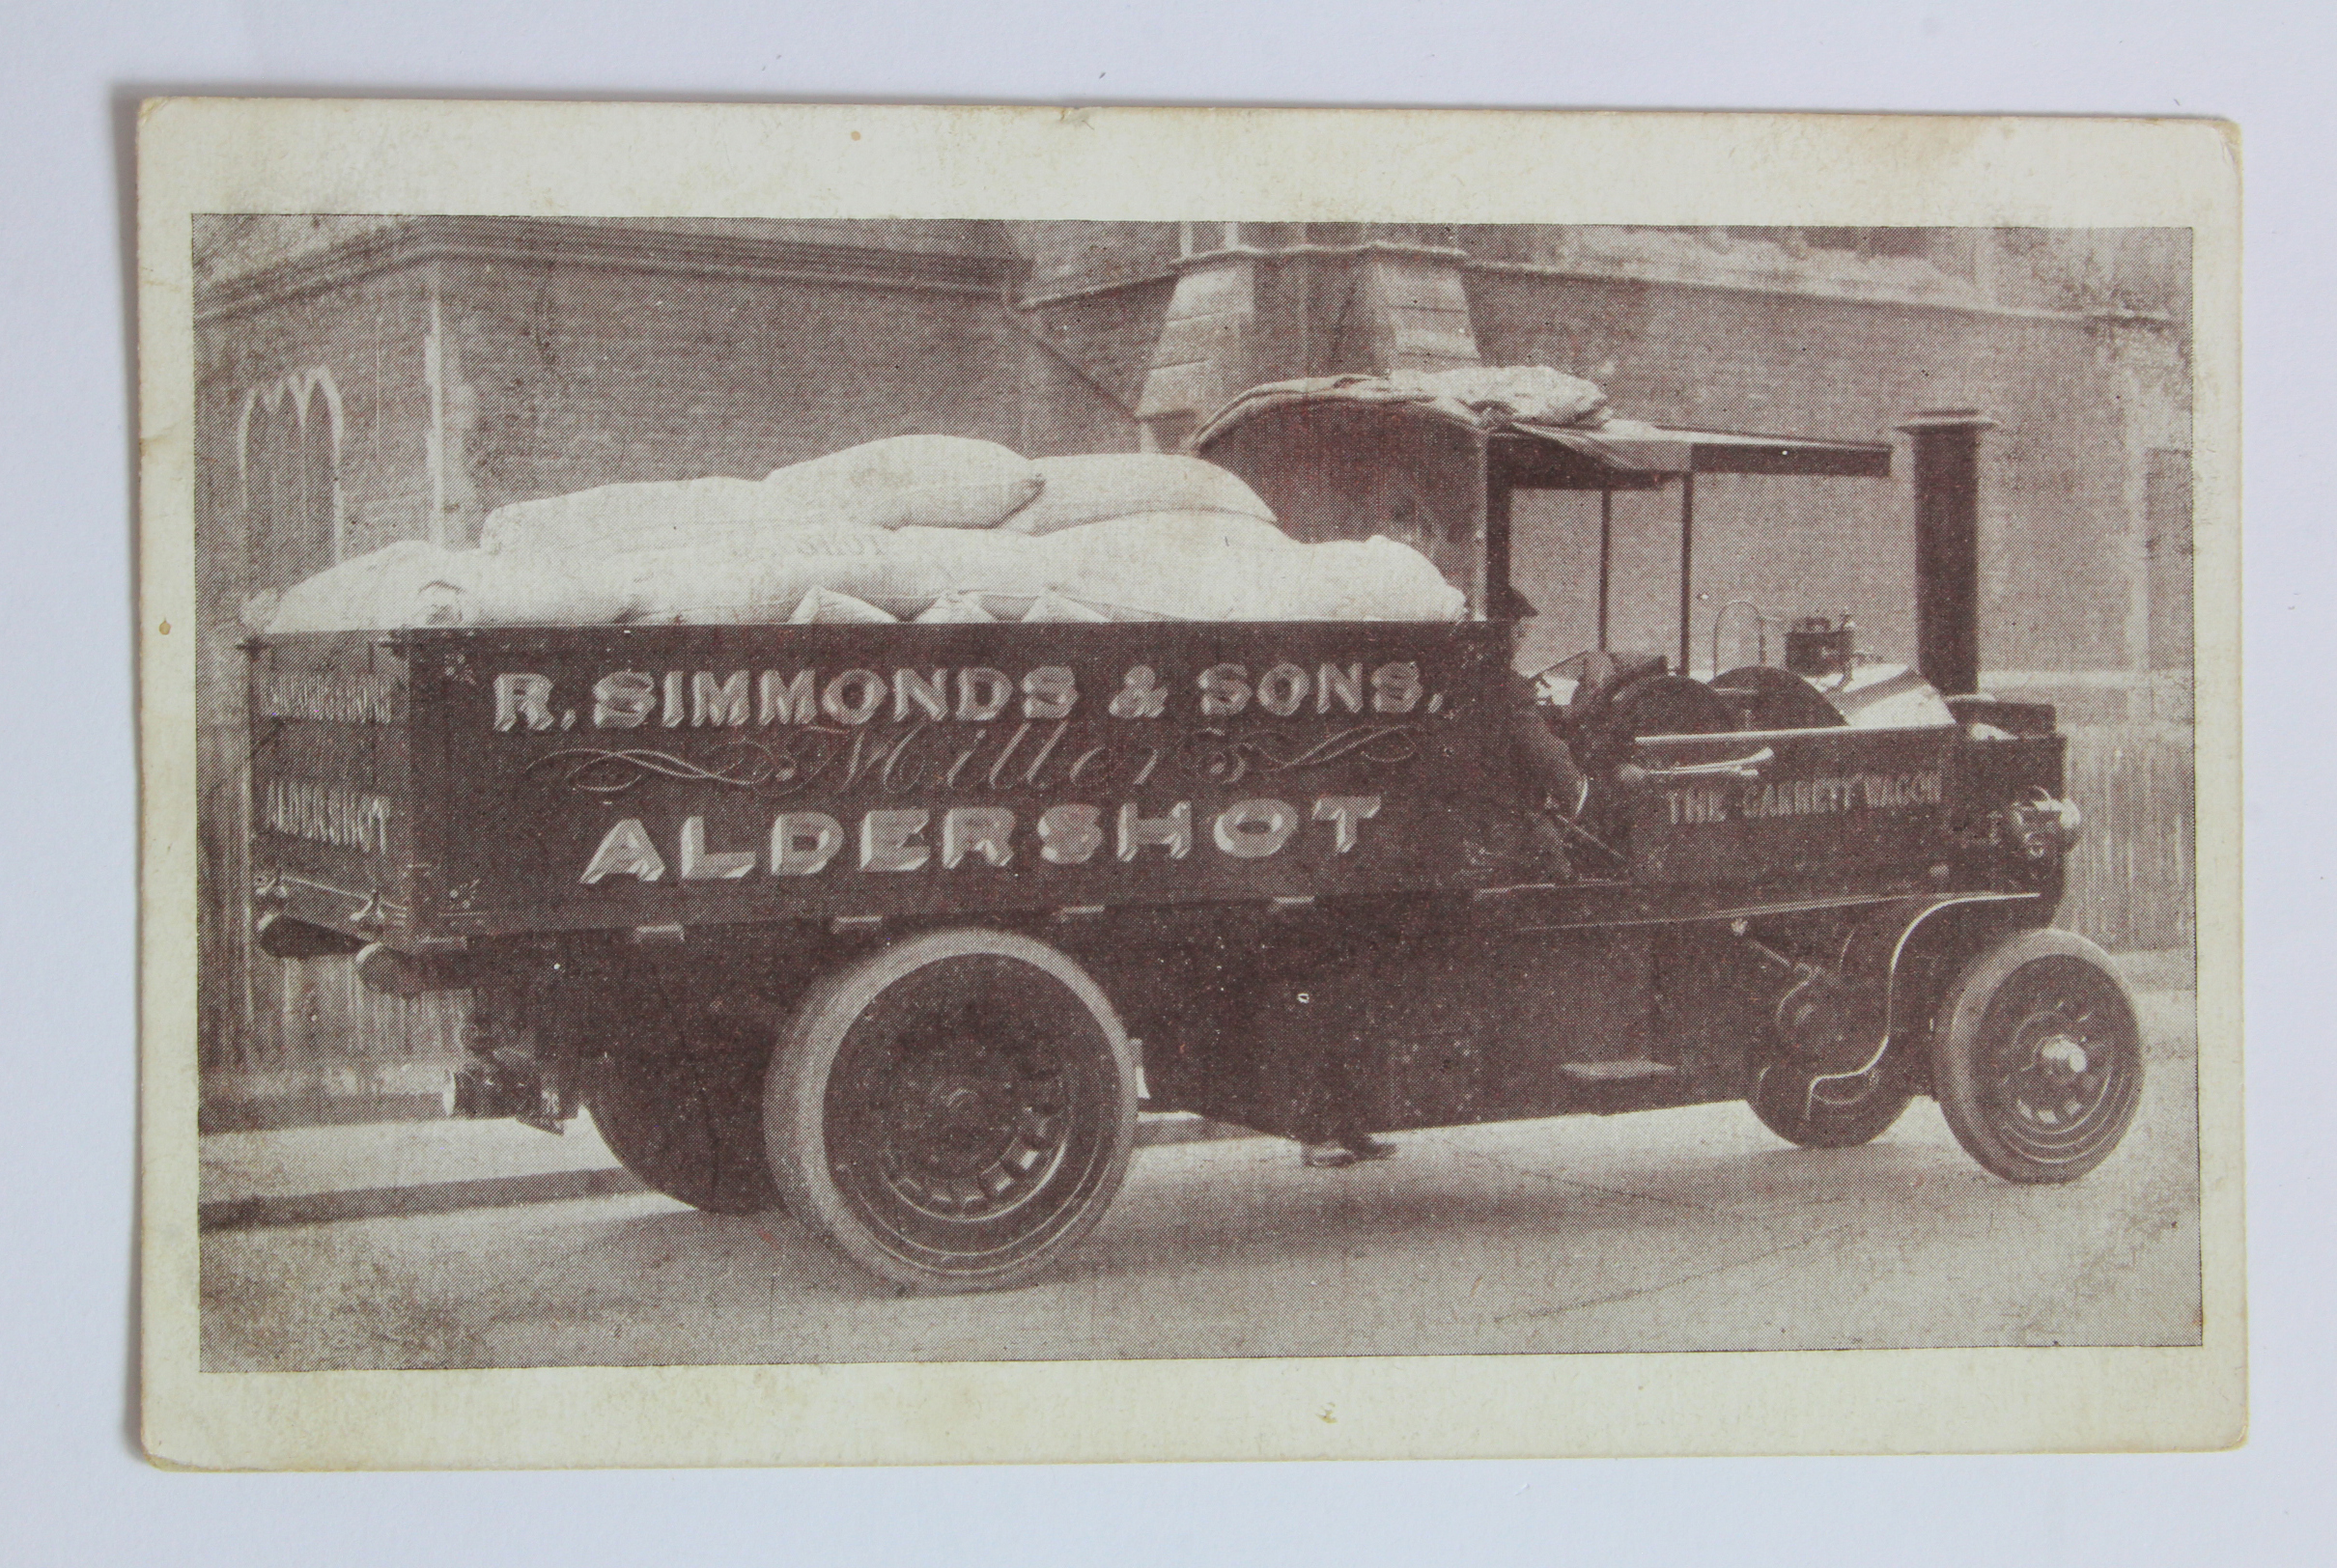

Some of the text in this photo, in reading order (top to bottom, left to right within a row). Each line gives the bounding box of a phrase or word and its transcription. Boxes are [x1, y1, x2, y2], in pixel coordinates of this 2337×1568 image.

[493, 673, 577, 732] R.
[592, 664, 1079, 729] SIMMONDS
[1109, 664, 1168, 718] &
[579, 797, 1381, 884] ALDERSHOT
